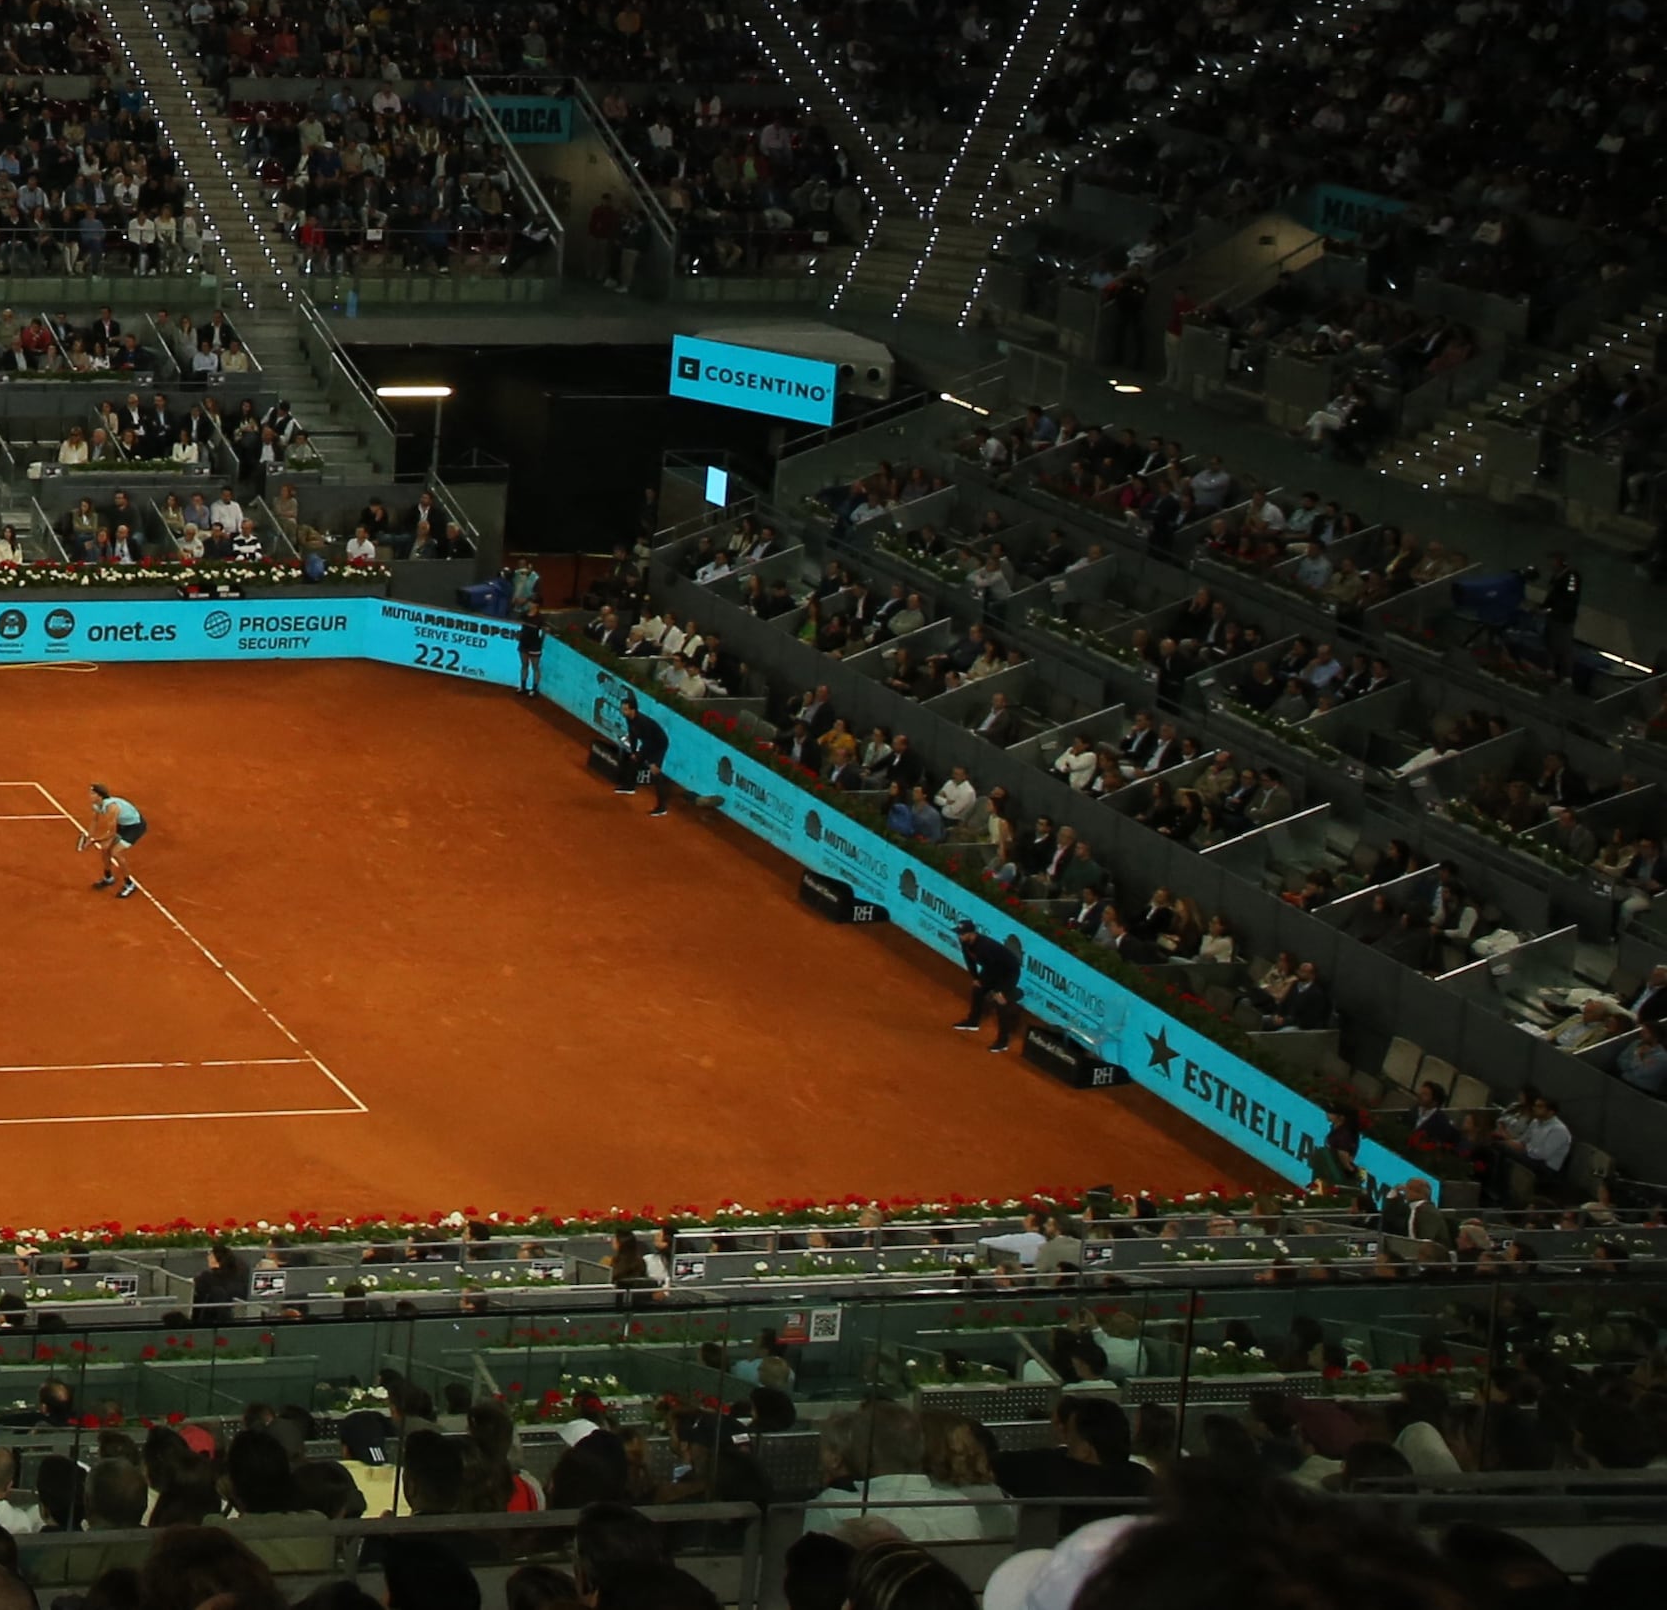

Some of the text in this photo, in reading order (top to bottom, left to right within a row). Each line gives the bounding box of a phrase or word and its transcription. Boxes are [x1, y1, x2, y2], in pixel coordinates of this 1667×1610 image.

[705, 365, 827, 402] COSENTINO
[87, 621, 177, 642] onet.es
[238, 615, 347, 632] PROSEGUR
[381, 605, 520, 641] MUTUA MADRID OPEN
[238, 636, 311, 650] SECURITY
[414, 626, 488, 649] SERVE SPEED
[414, 643, 461, 671] 222
[1182, 1058, 1316, 1167] ESTRELLA
